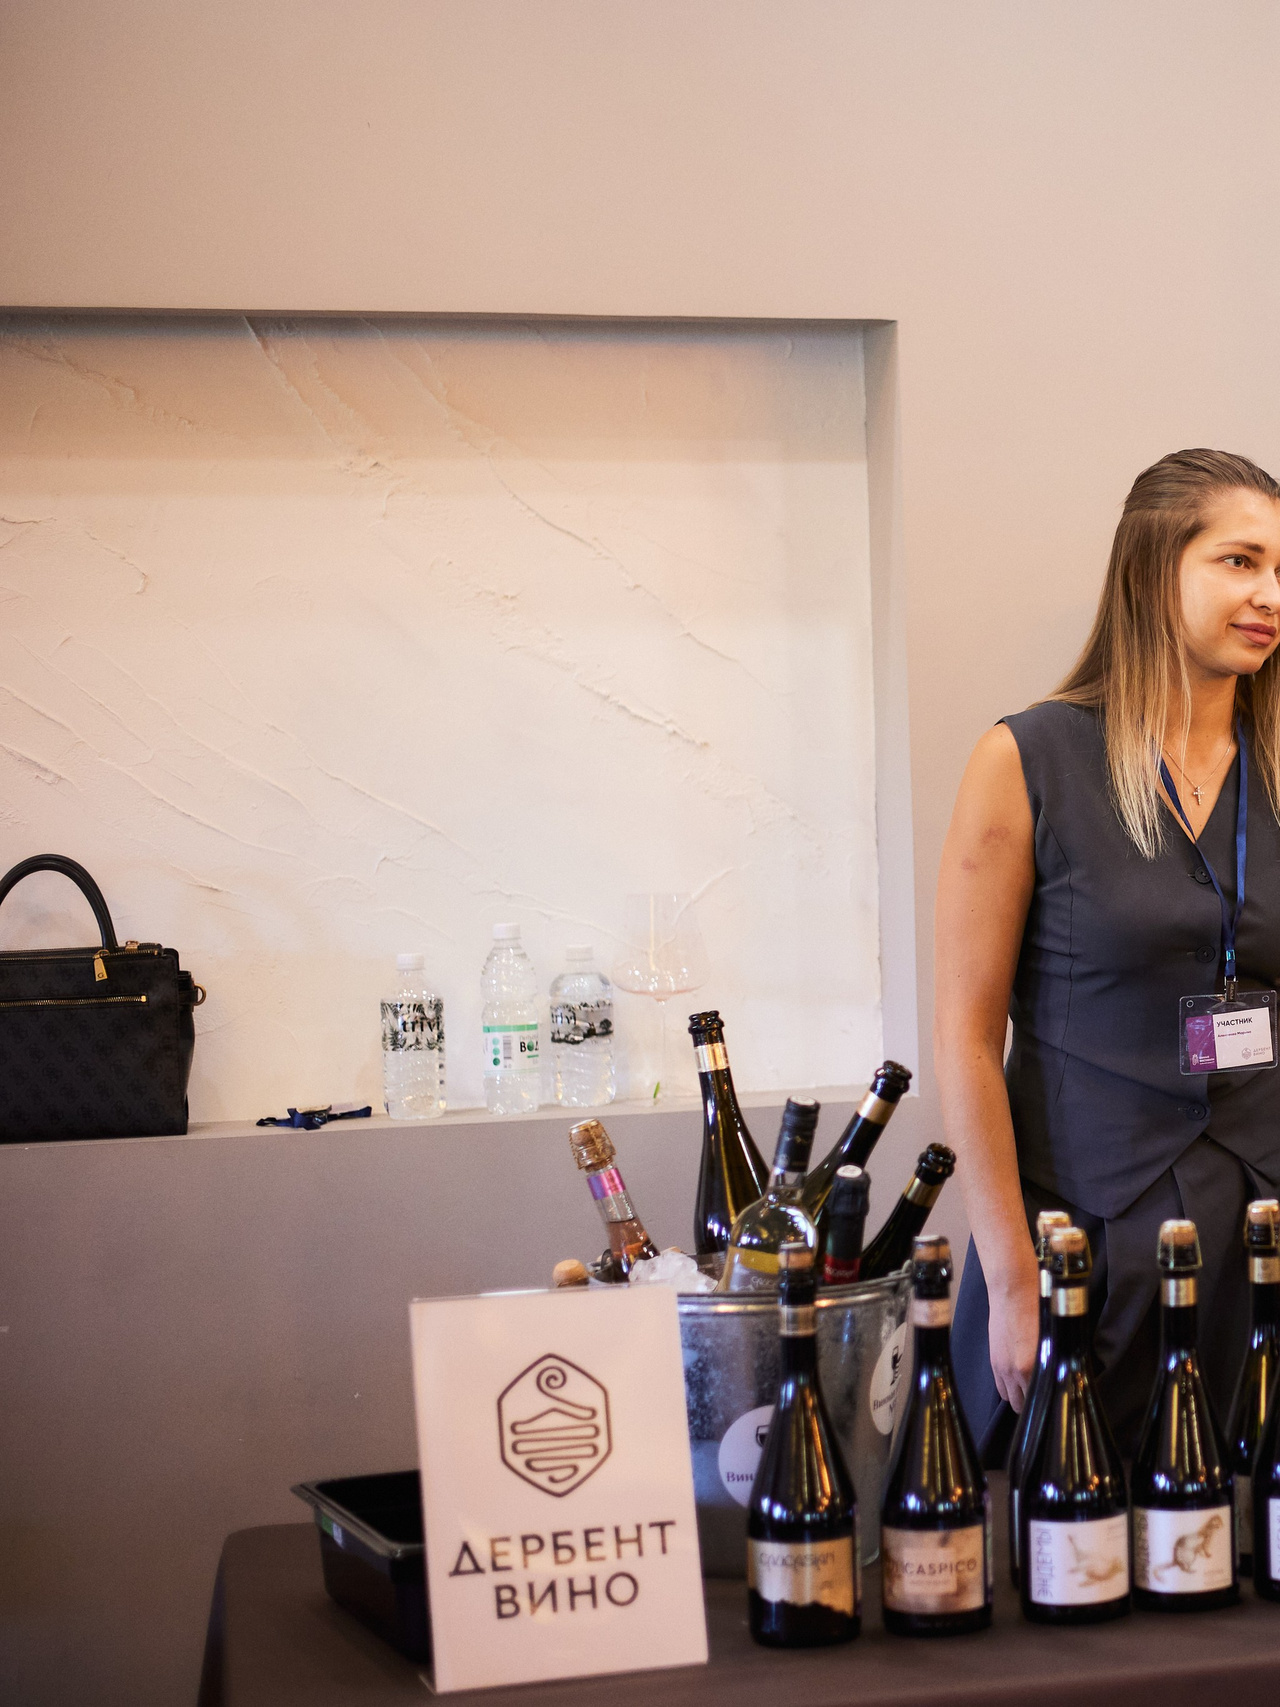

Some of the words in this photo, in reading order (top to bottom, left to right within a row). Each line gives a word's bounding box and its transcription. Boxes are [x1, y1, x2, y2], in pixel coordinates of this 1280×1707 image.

[1217, 1017, 1252, 1027] УЧАСТНИК
[726, 1471, 754, 1482] Вин
[448, 1520, 677, 1578] ДЕРБЕНТ
[904, 1558, 977, 1576] CASPICO
[494, 1571, 639, 1620] ВИНО
